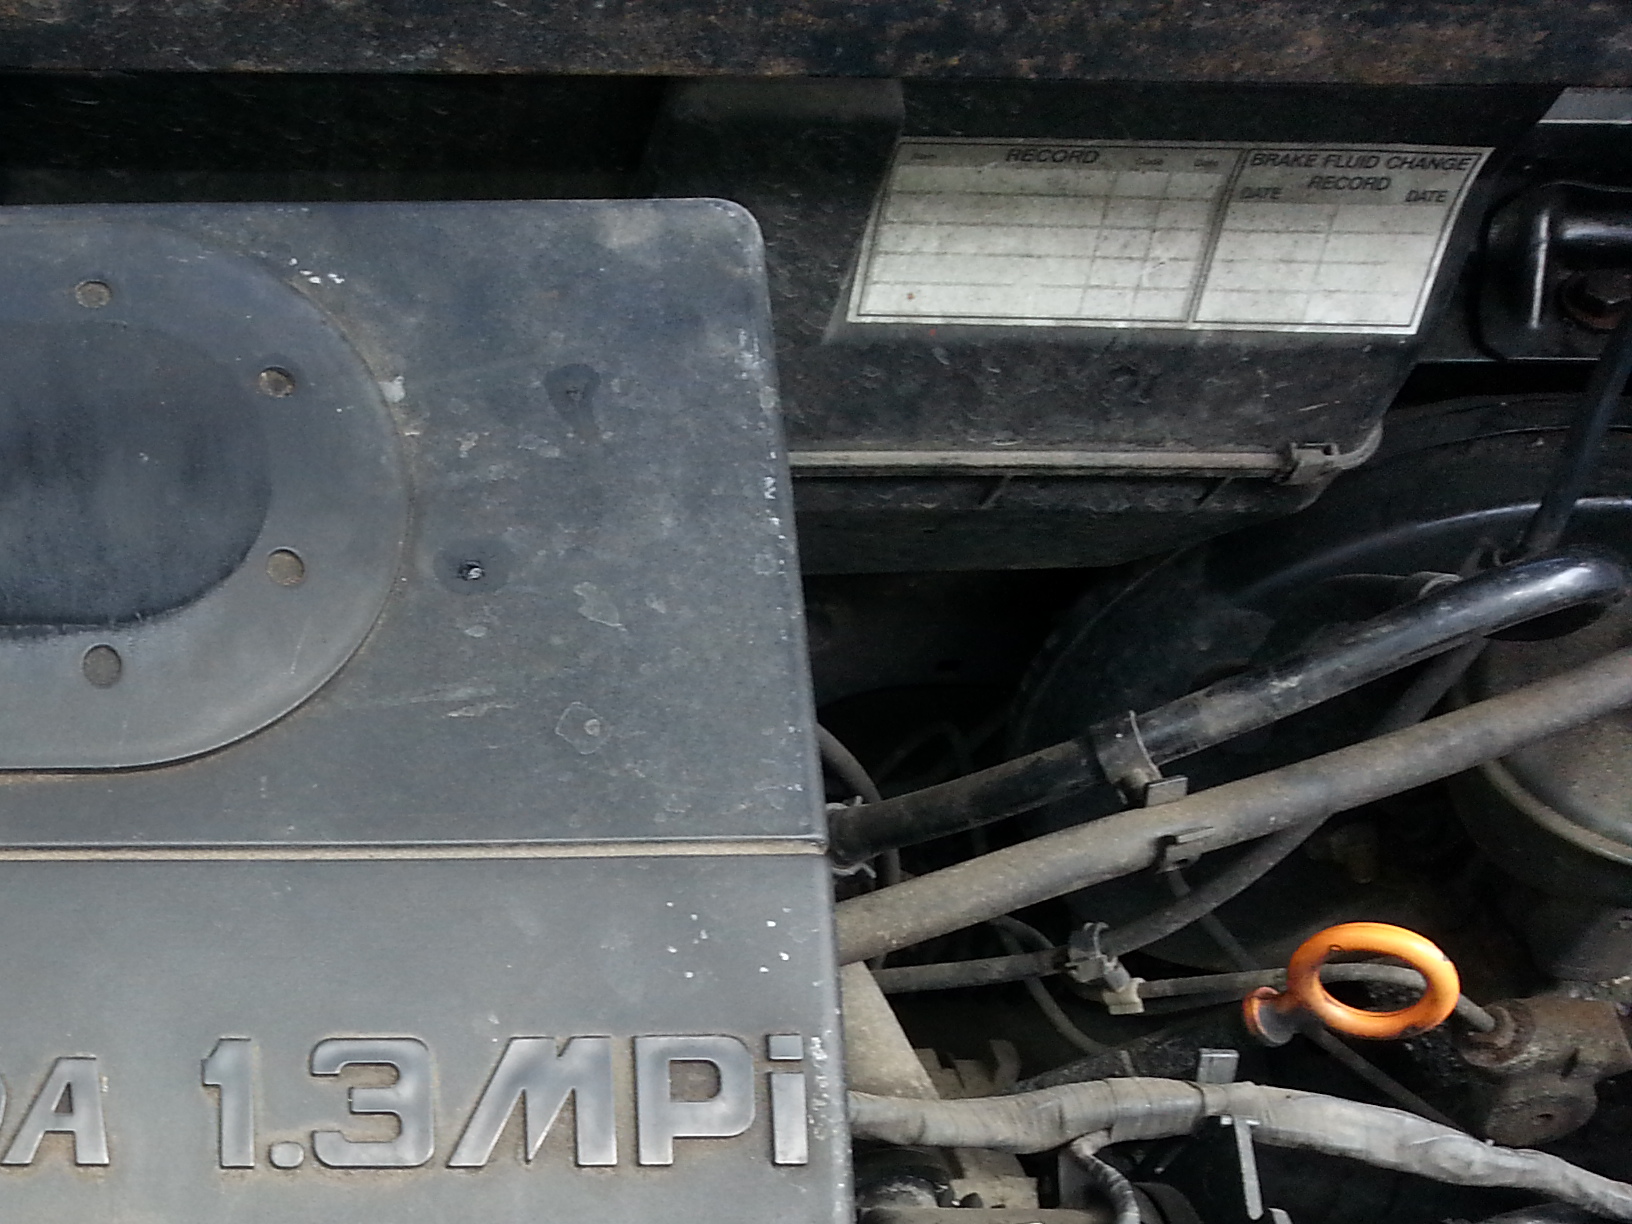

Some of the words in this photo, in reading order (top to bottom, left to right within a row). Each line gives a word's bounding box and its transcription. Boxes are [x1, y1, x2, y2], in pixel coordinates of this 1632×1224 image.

[1005, 148, 1100, 165] RECORD
[1250, 153, 1317, 169] BRAKE
[1322, 154, 1380, 169] FLUID
[1385, 155, 1473, 171] CHANGE
[1306, 175, 1392, 191] RECORD
[1239, 187, 1283, 200] DATE
[1405, 189, 1449, 203] DATE
